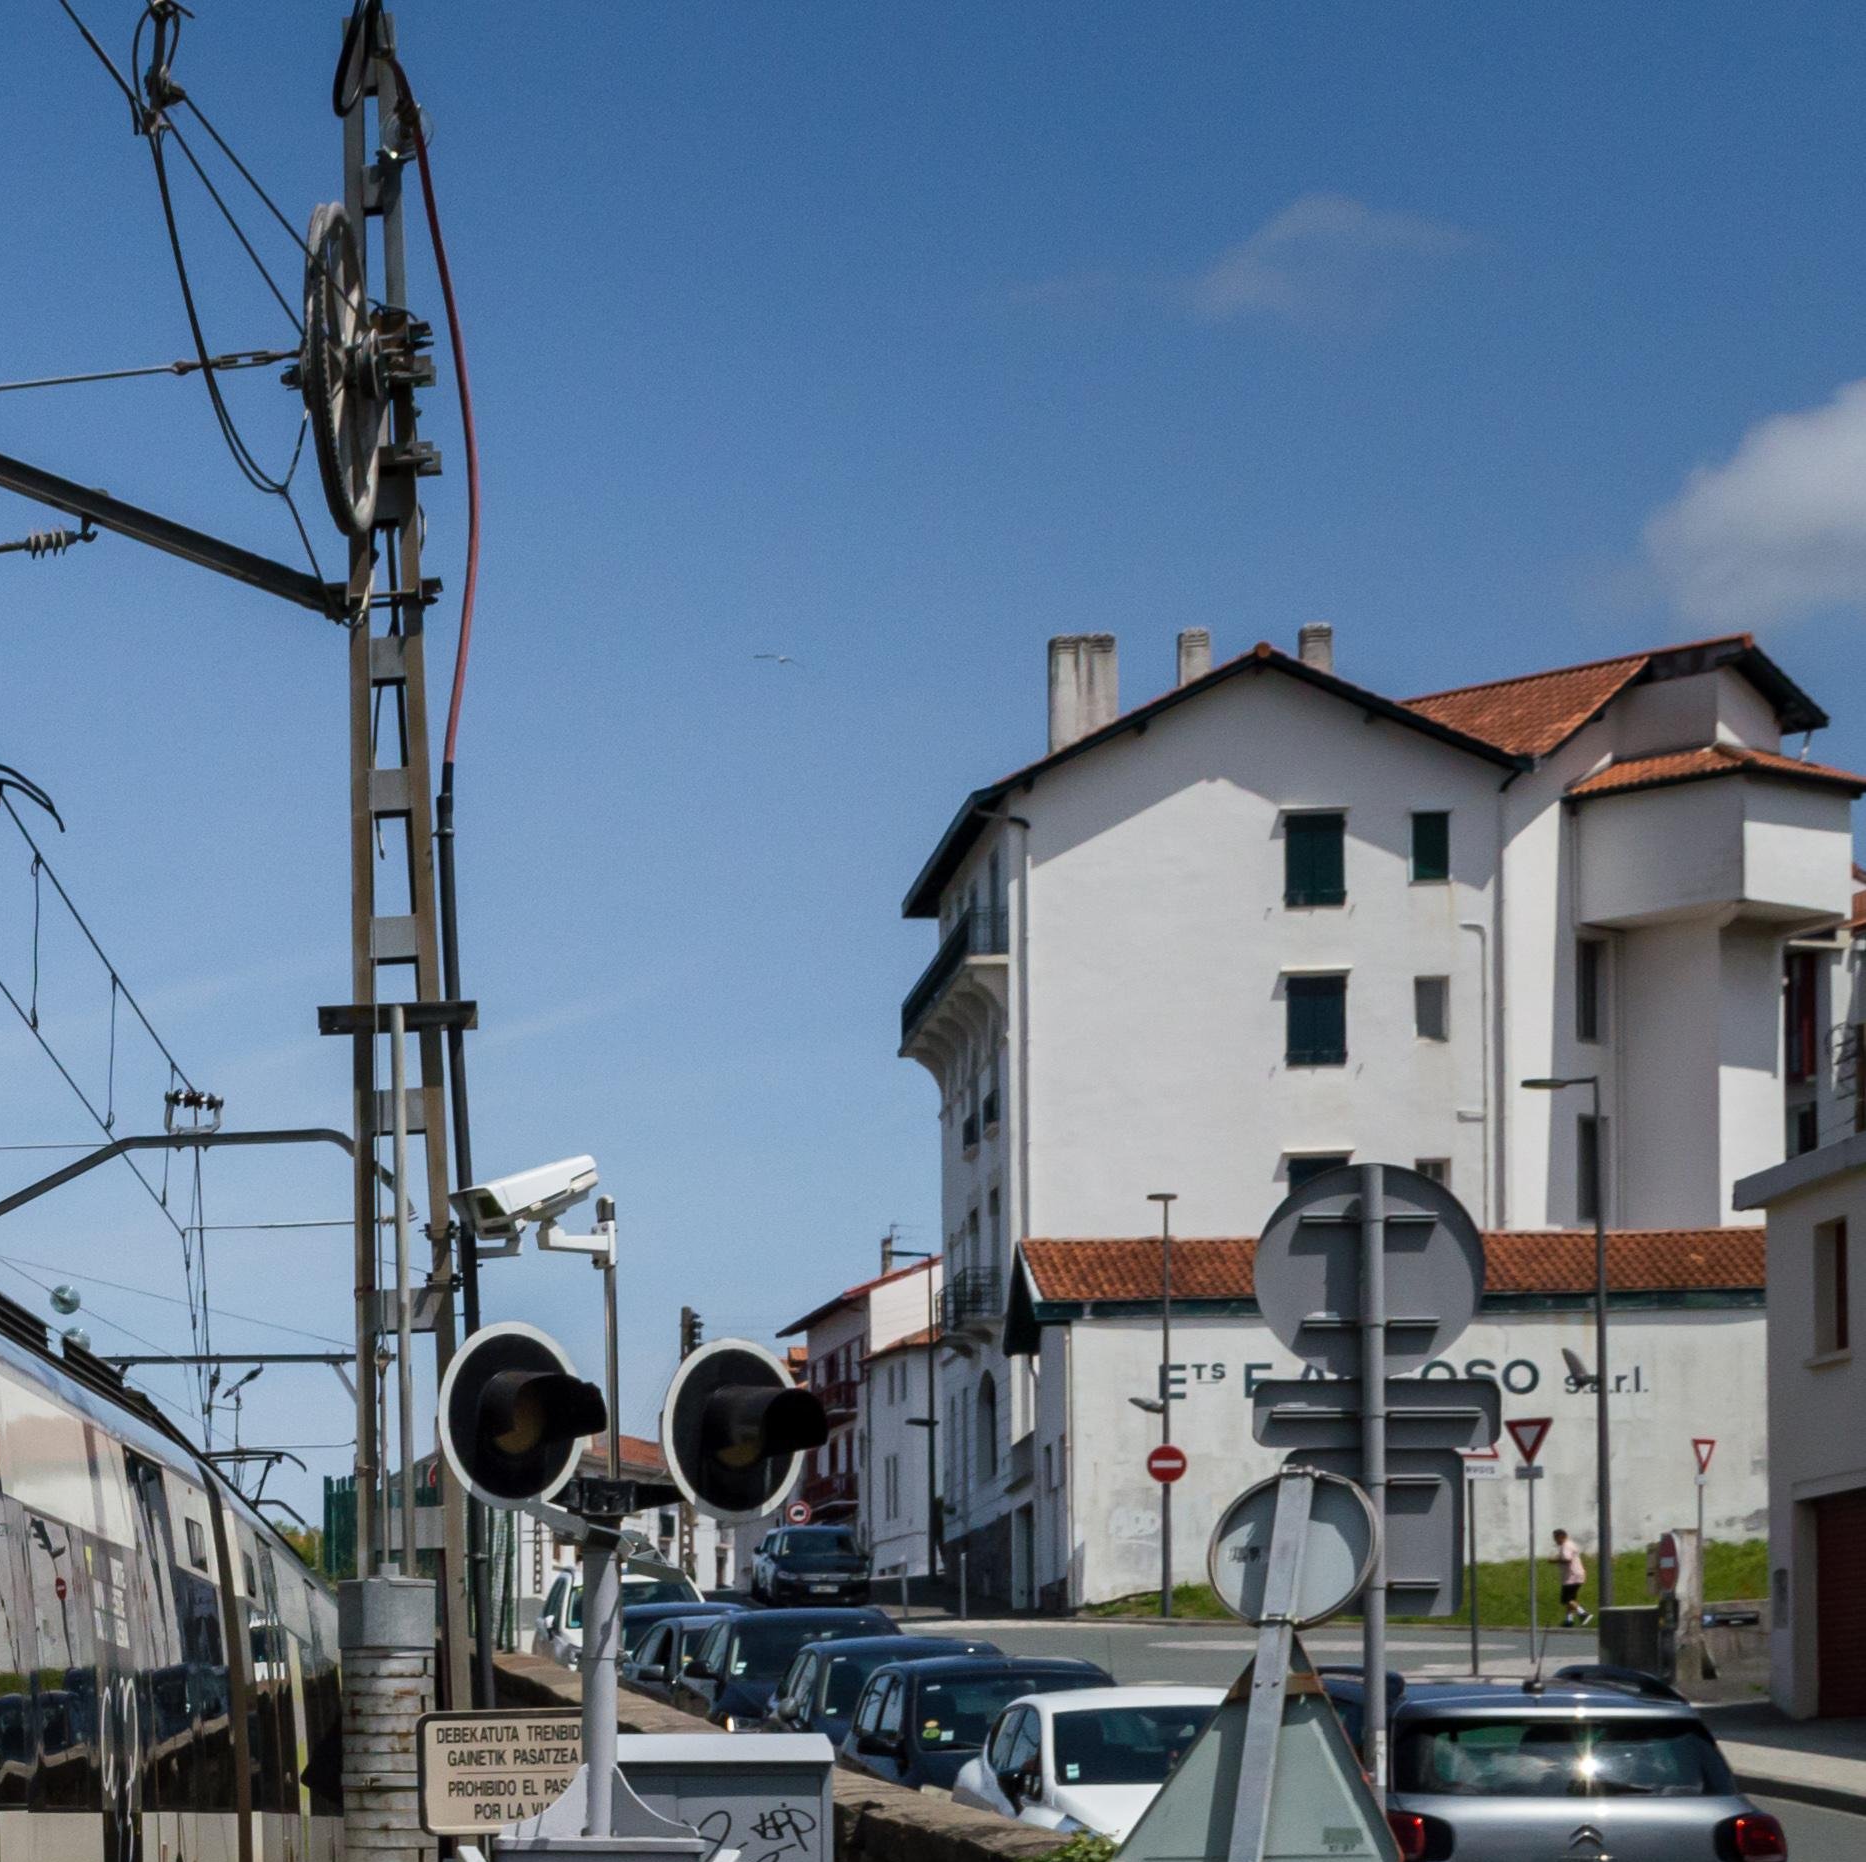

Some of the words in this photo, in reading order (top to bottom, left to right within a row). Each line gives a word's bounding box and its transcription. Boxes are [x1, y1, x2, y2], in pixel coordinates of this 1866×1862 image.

[436, 1725, 519, 1744] DEBEKATUTA
[526, 1724, 582, 1742] TRENBID
[447, 1749, 507, 1767] GAINETIK
[513, 1747, 579, 1766] PASATZEA
[448, 1780, 516, 1797] PROHIBIDO
[523, 1779, 539, 1796] EL
[544, 1778, 573, 1795] PAS
[474, 1803, 502, 1820] POR
[507, 1802, 525, 1819] LA
